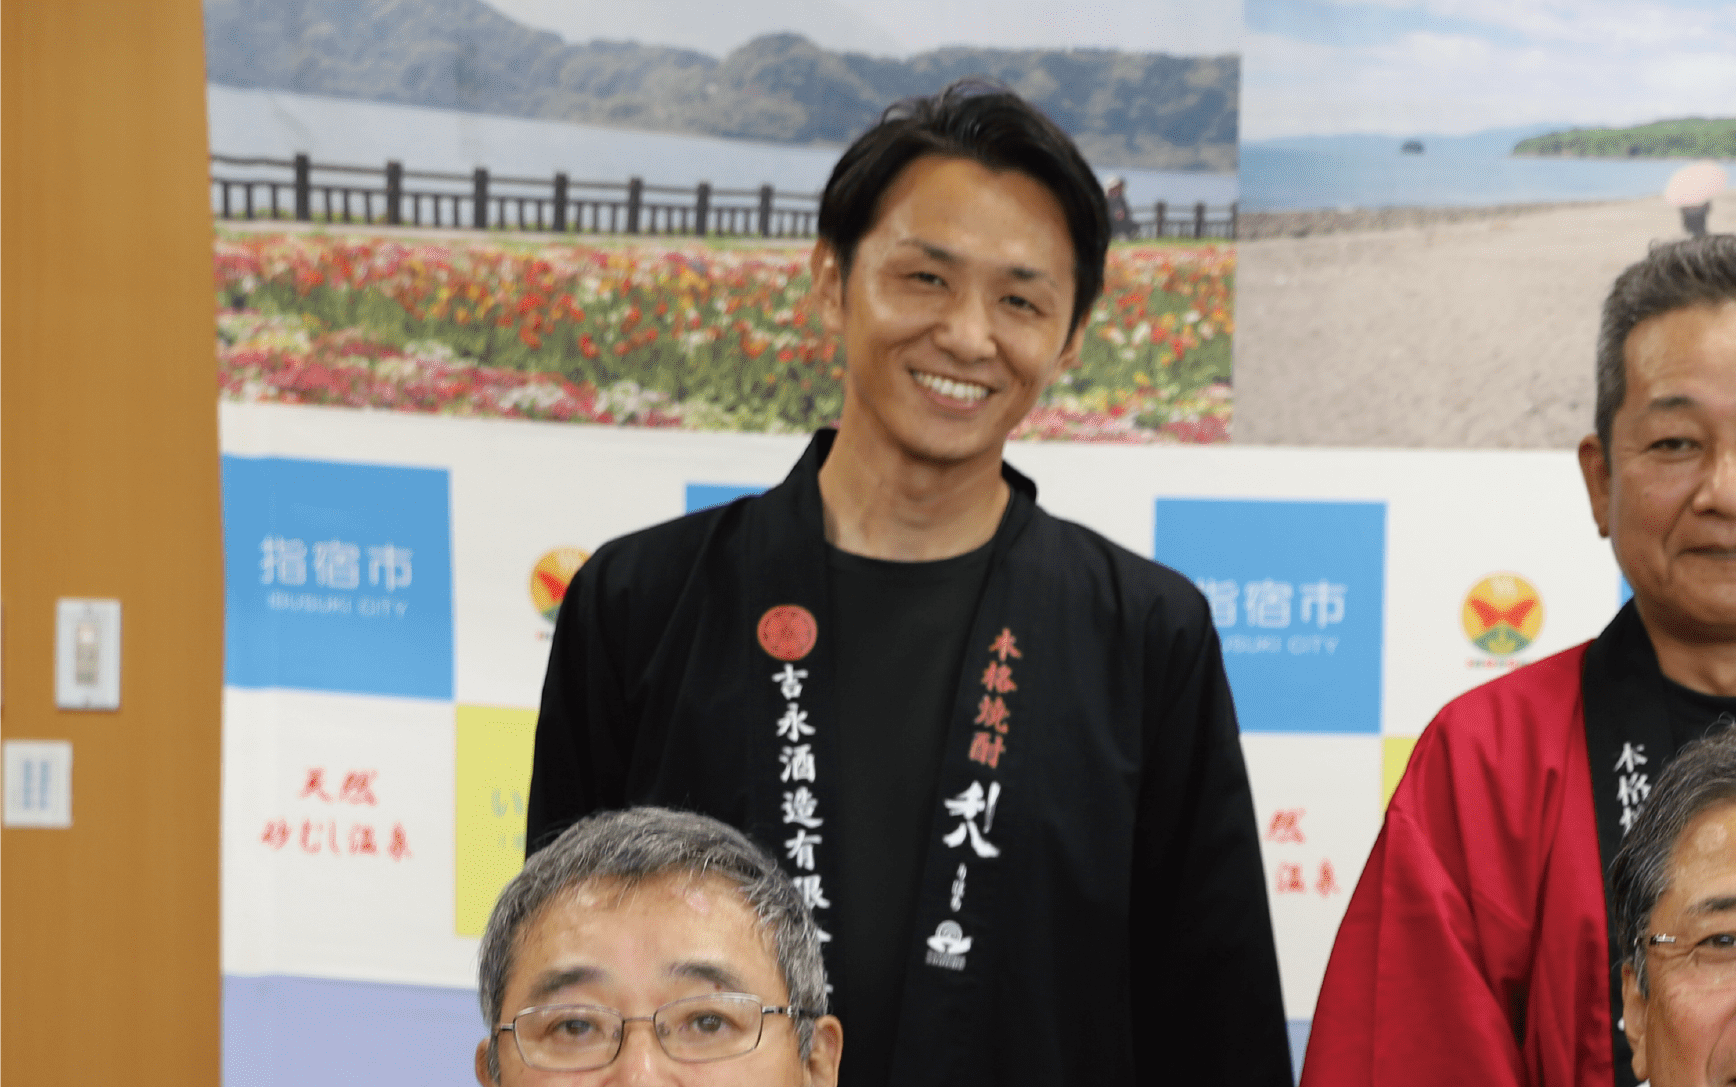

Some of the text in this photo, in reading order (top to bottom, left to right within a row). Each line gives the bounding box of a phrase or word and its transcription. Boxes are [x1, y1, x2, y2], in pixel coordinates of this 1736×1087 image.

[261, 536, 413, 592] 指宿市
[1196, 577, 1347, 628] 指宿市
[772, 664, 832, 993] 吉永酒造有限
[943, 780, 1002, 859] 利八
